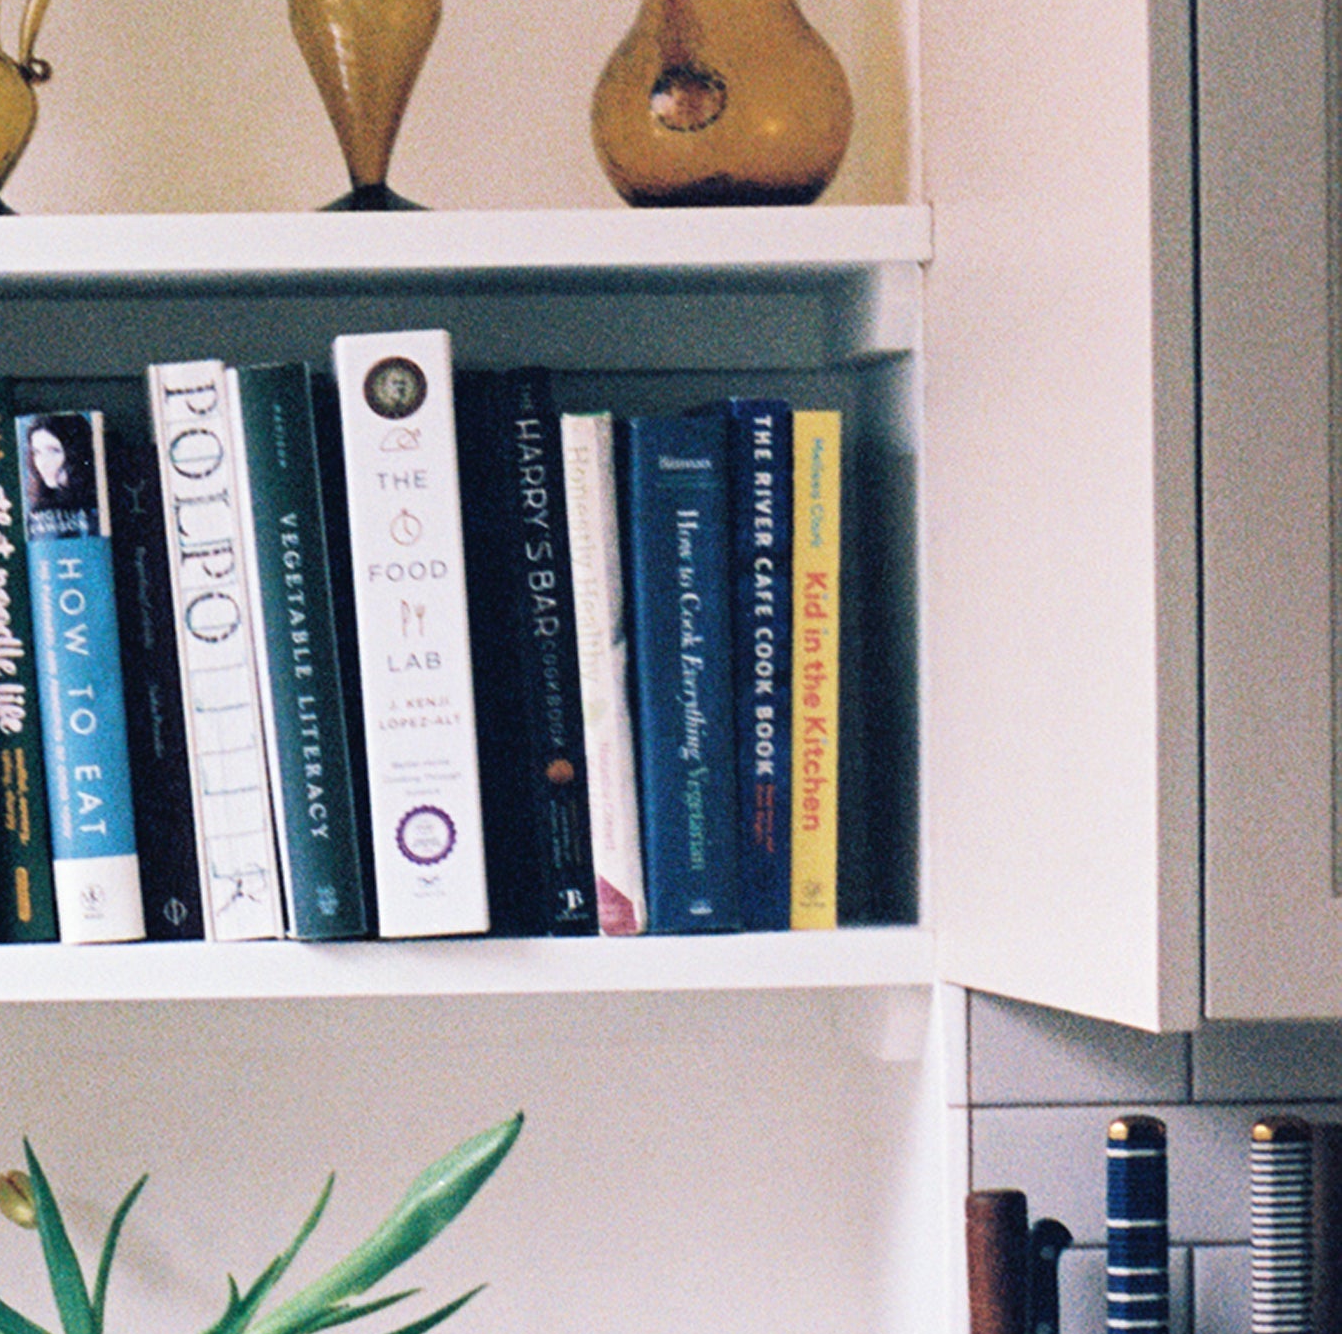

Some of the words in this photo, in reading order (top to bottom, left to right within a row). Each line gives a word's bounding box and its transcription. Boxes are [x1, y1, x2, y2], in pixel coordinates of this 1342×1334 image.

[753, 415, 773, 461] THE
[163, 380, 243, 645] POLPO
[376, 470, 428, 490] THE
[514, 418, 553, 563] HARRY'S
[567, 445, 598, 567] Honestly
[753, 471, 773, 548] RIVER
[676, 509, 700, 561] How
[278, 512, 313, 679] VEGETABLE
[367, 559, 448, 583] FOOD
[528, 570, 560, 639] BAR
[677, 566, 699, 587] to
[754, 557, 773, 617] CAFE
[802, 570, 829, 620] Kid
[57, 558, 90, 656] HOW
[574, 579, 604, 684] Healthy
[678, 592, 703, 649] Cook
[802, 626, 830, 653] in
[387, 651, 442, 673] LAB
[754, 627, 774, 695] COOK
[802, 660, 829, 709] the
[68, 685, 96, 736] TO
[676, 653, 706, 762] Everything
[755, 705, 775, 776] BOOK
[73, 764, 107, 836] EAT
[295, 695, 331, 841] LITERACY
[800, 715, 829, 833] Kitchen
[684, 766, 712, 871] Vegetarian
